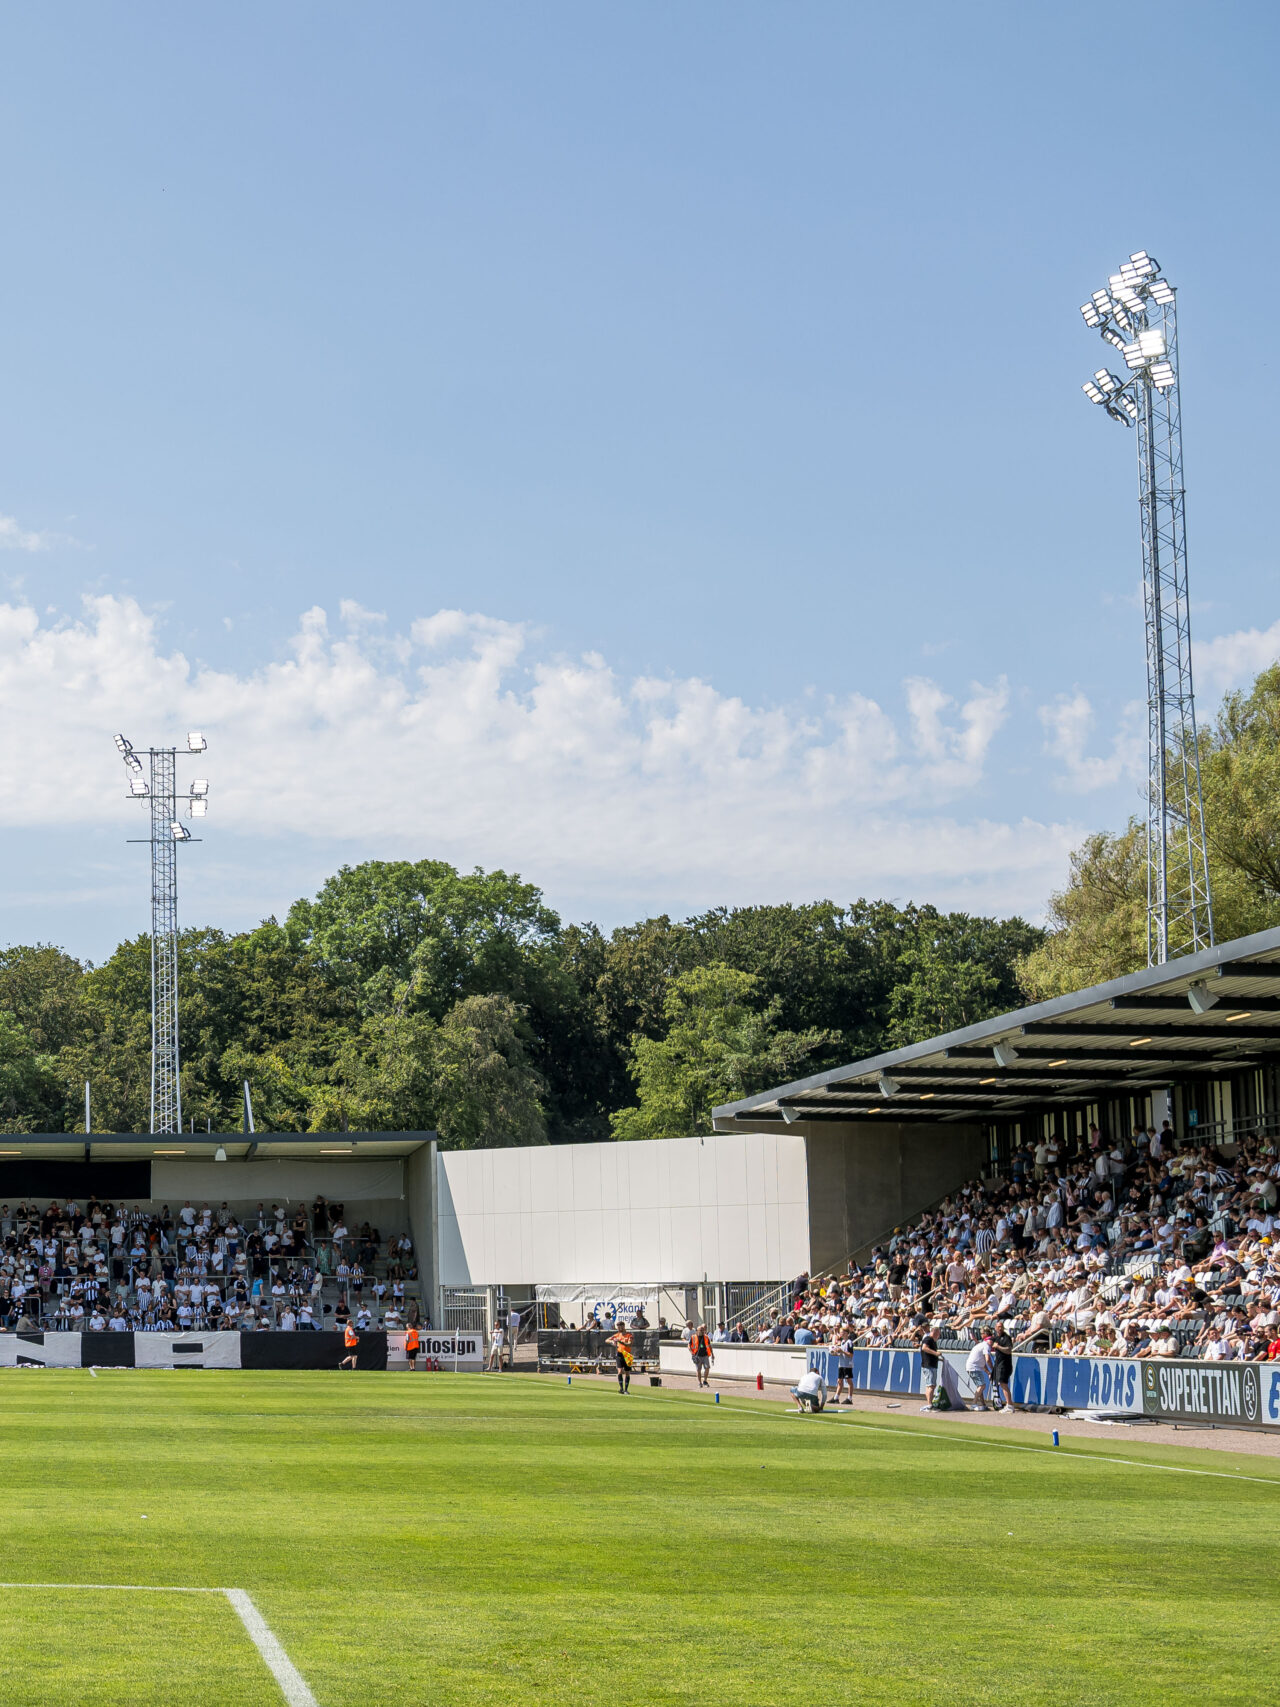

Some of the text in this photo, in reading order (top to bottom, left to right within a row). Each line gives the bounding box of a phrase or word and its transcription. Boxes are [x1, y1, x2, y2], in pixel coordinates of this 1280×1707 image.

[618, 1302, 645, 1313] Skåne
[417, 1337, 476, 1356] nfosign
[1090, 1362, 1136, 1408] ADHS
[1159, 1366, 1240, 1415] SUPERETTAN
